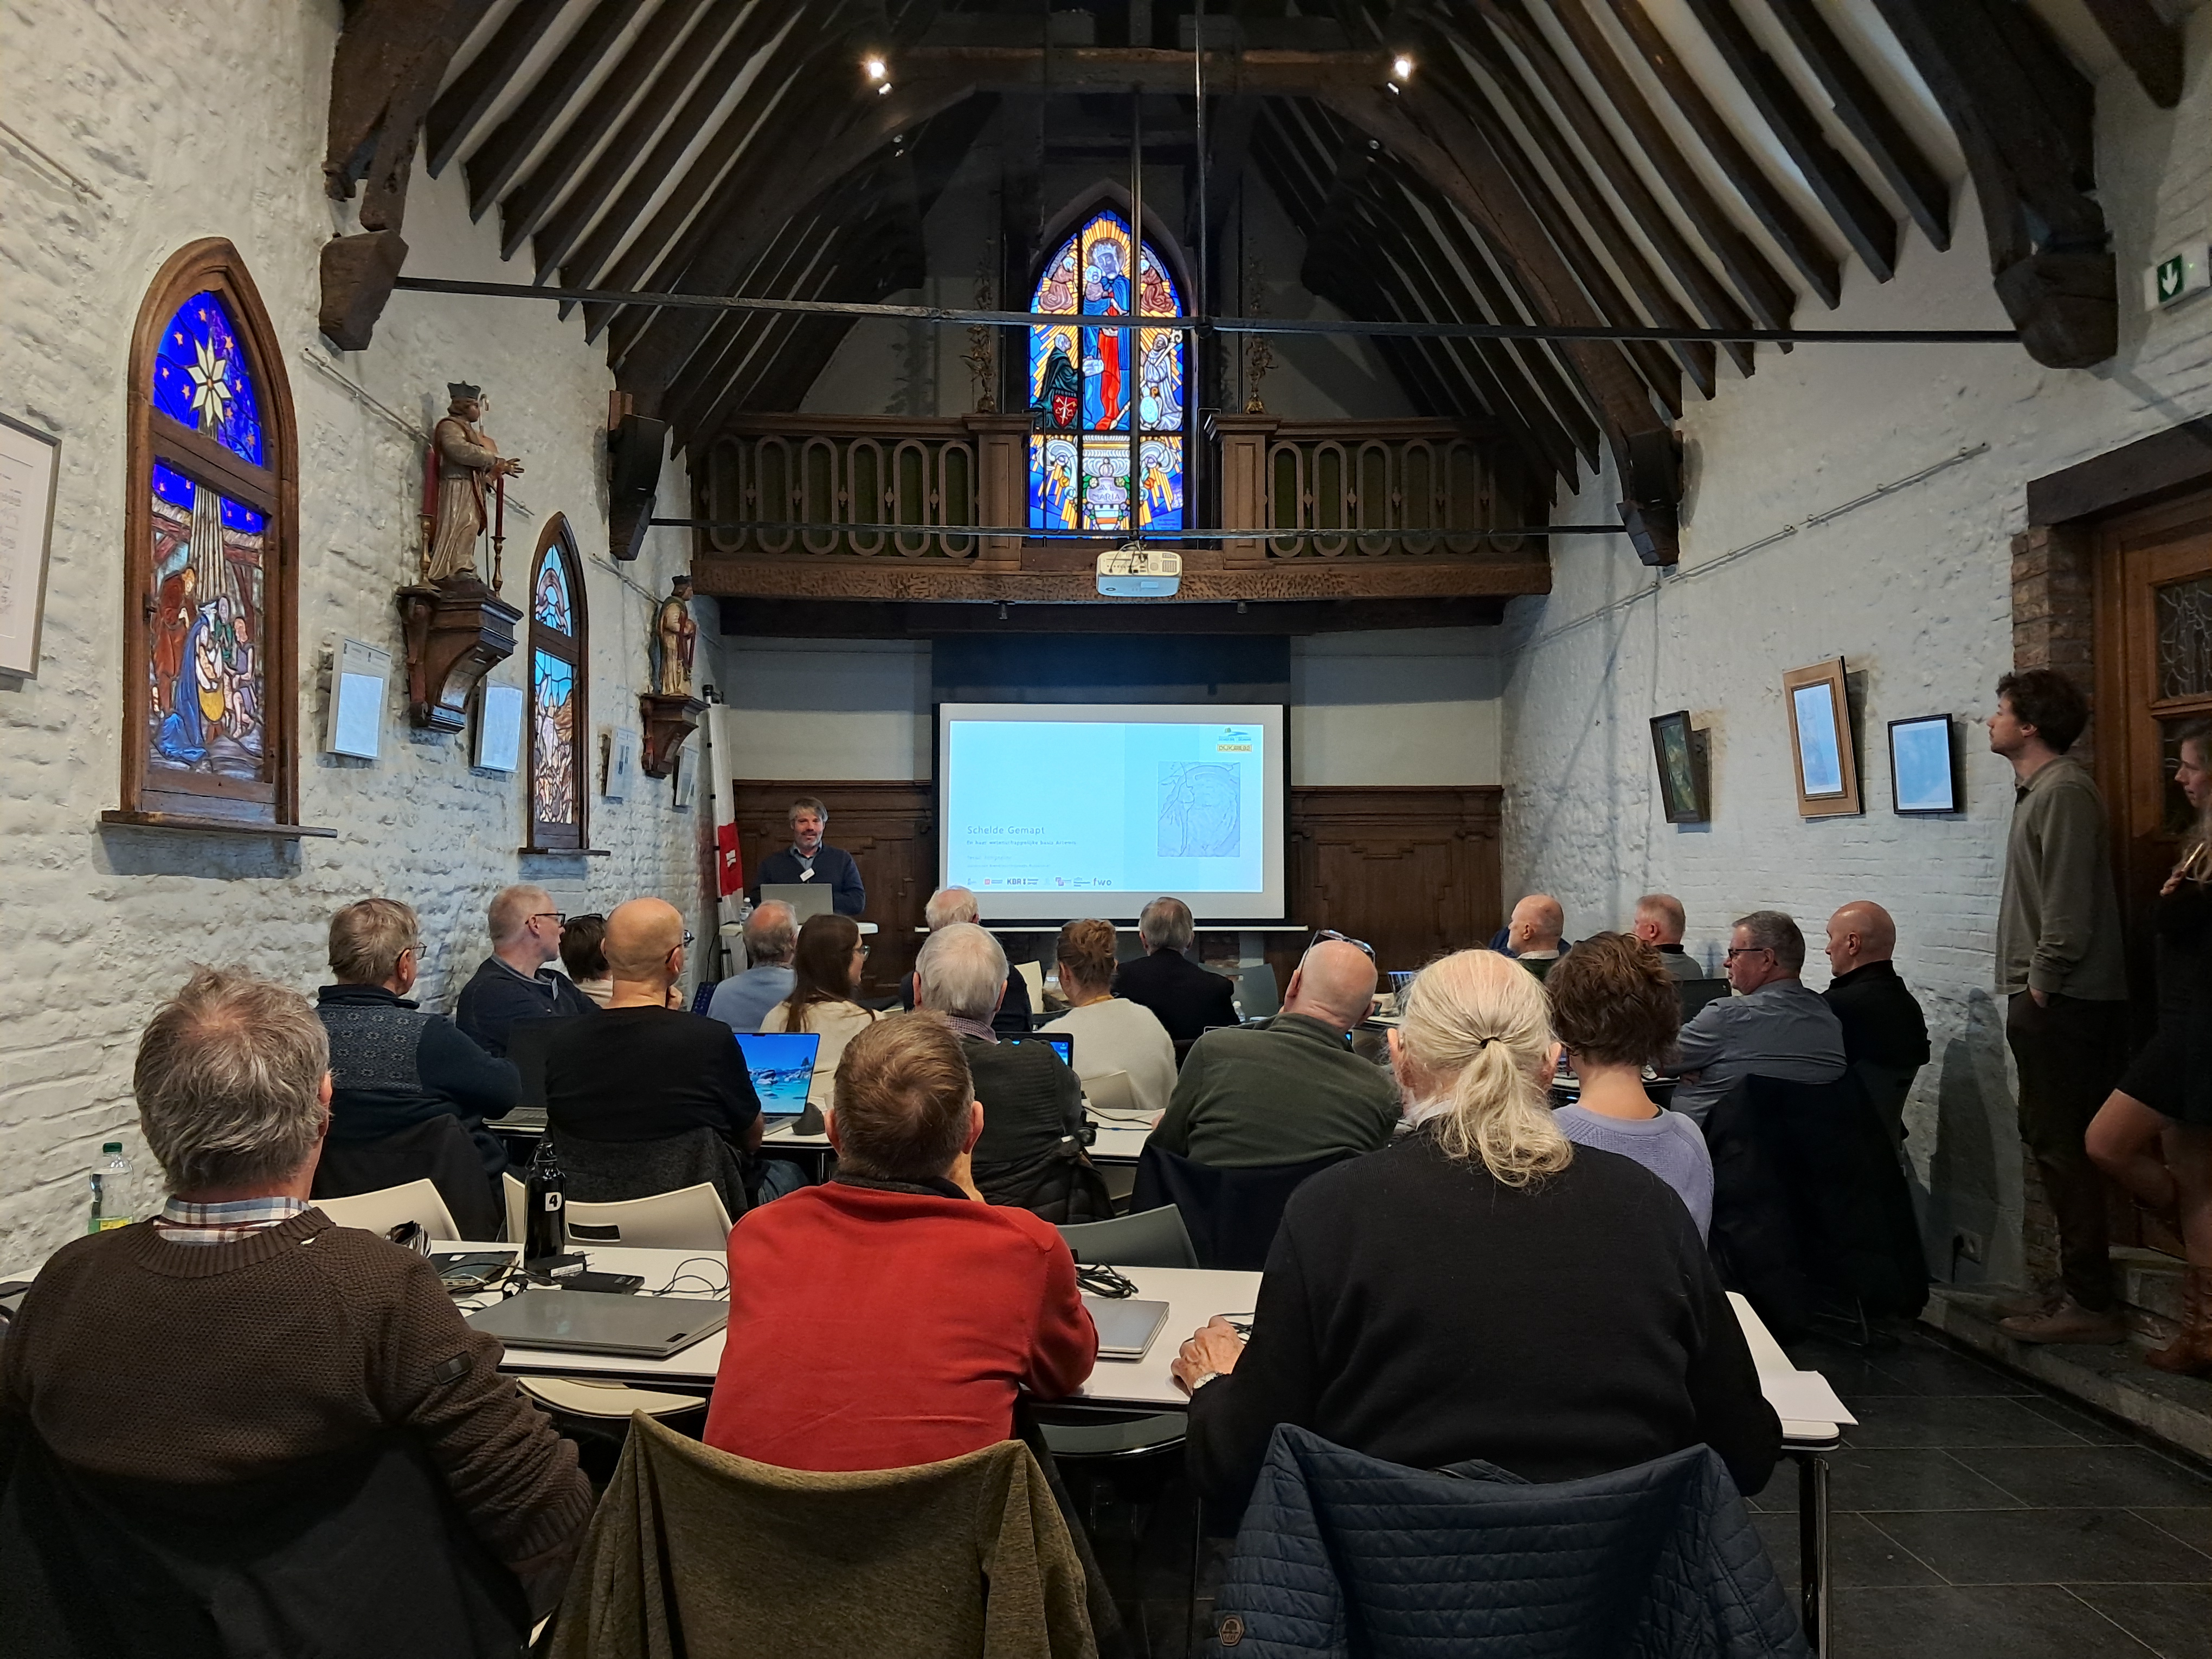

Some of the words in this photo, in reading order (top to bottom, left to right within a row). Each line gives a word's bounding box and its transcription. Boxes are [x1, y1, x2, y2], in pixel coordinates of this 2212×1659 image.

[1092, 493, 1120, 501] MARIA
[967, 825, 1004, 834] Schelde
[1007, 826, 1045, 835] Gemapt
[1093, 877, 1112, 886] fwo
[549, 1194, 558, 1207] 4
